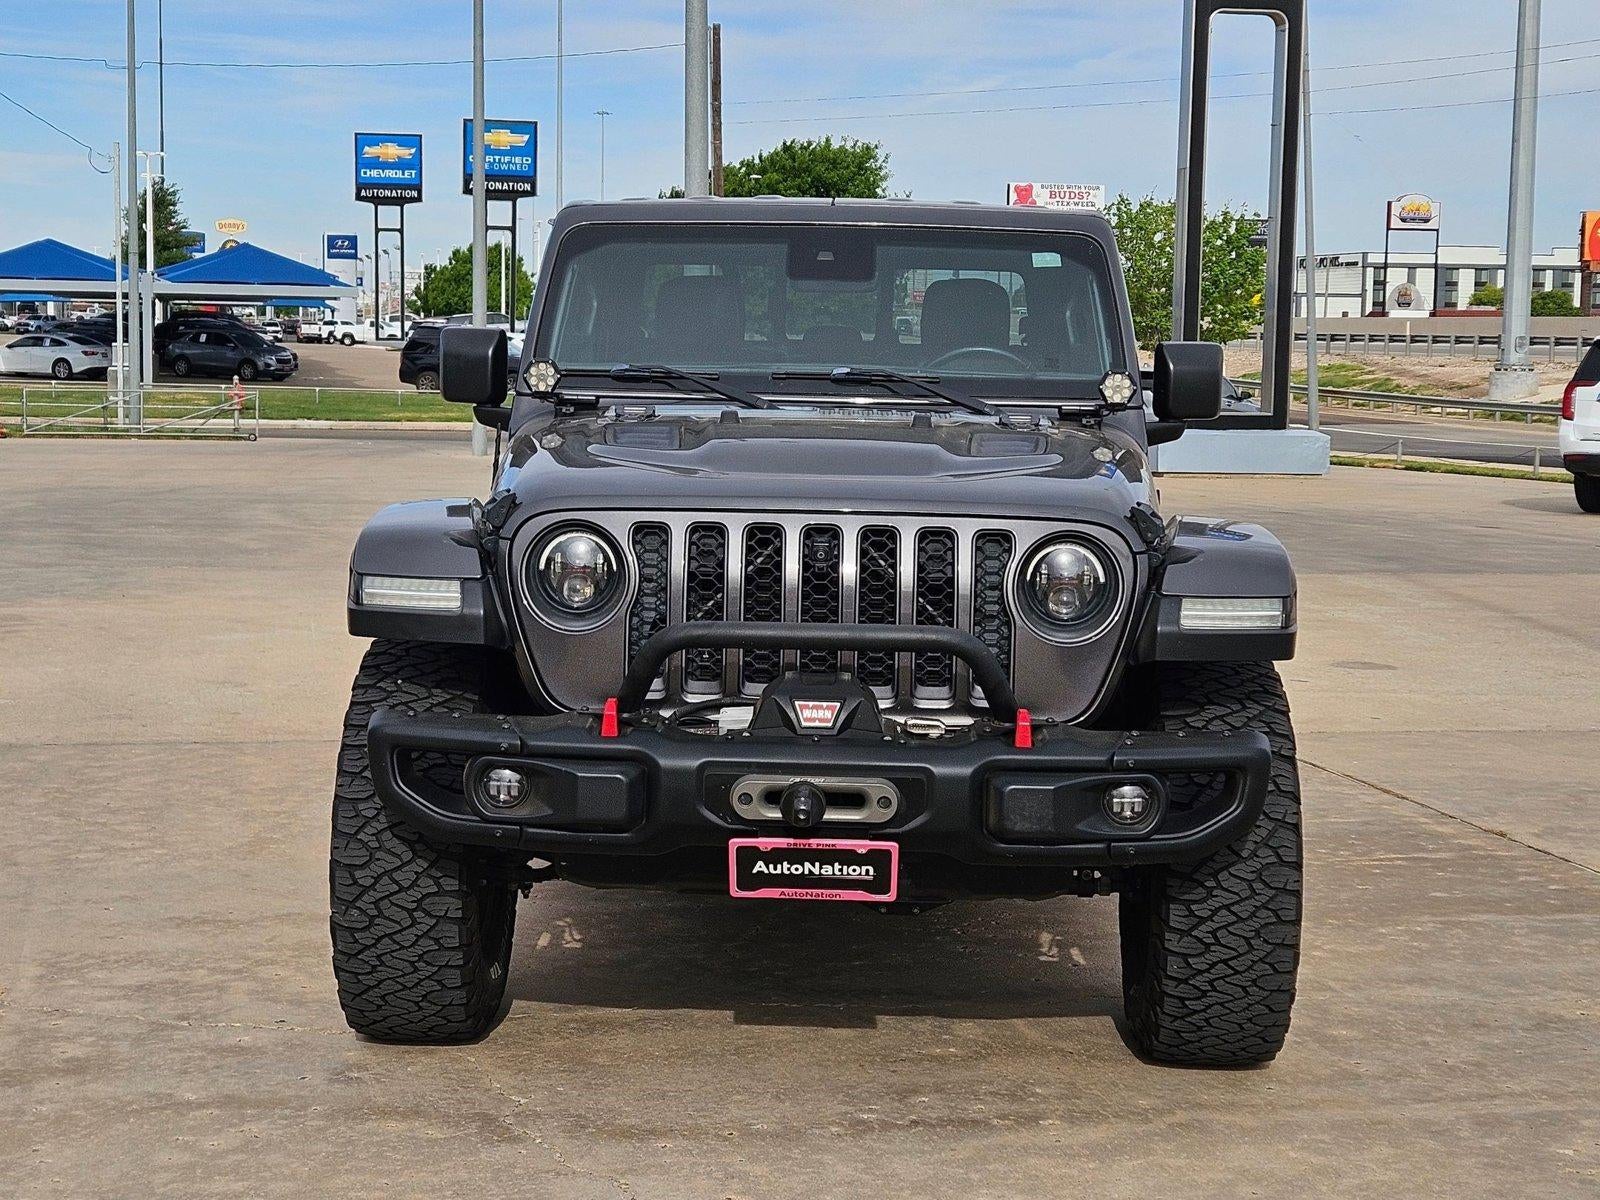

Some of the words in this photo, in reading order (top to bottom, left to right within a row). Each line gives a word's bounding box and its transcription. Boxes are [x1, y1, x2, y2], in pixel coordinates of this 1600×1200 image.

[469, 155, 532, 164] CRTIFIED
[484, 163, 529, 171] E-OWNED
[361, 169, 417, 179] CHEVROLET
[469, 181, 531, 192] ATONATION
[360, 188, 418, 198] AUTONATION
[1049, 190, 1091, 200] BUDS?
[218, 222, 245, 230] Denny's
[802, 708, 832, 719] WARN
[752, 860, 875, 876] AutoNation
[778, 890, 843, 899] AutoNation
